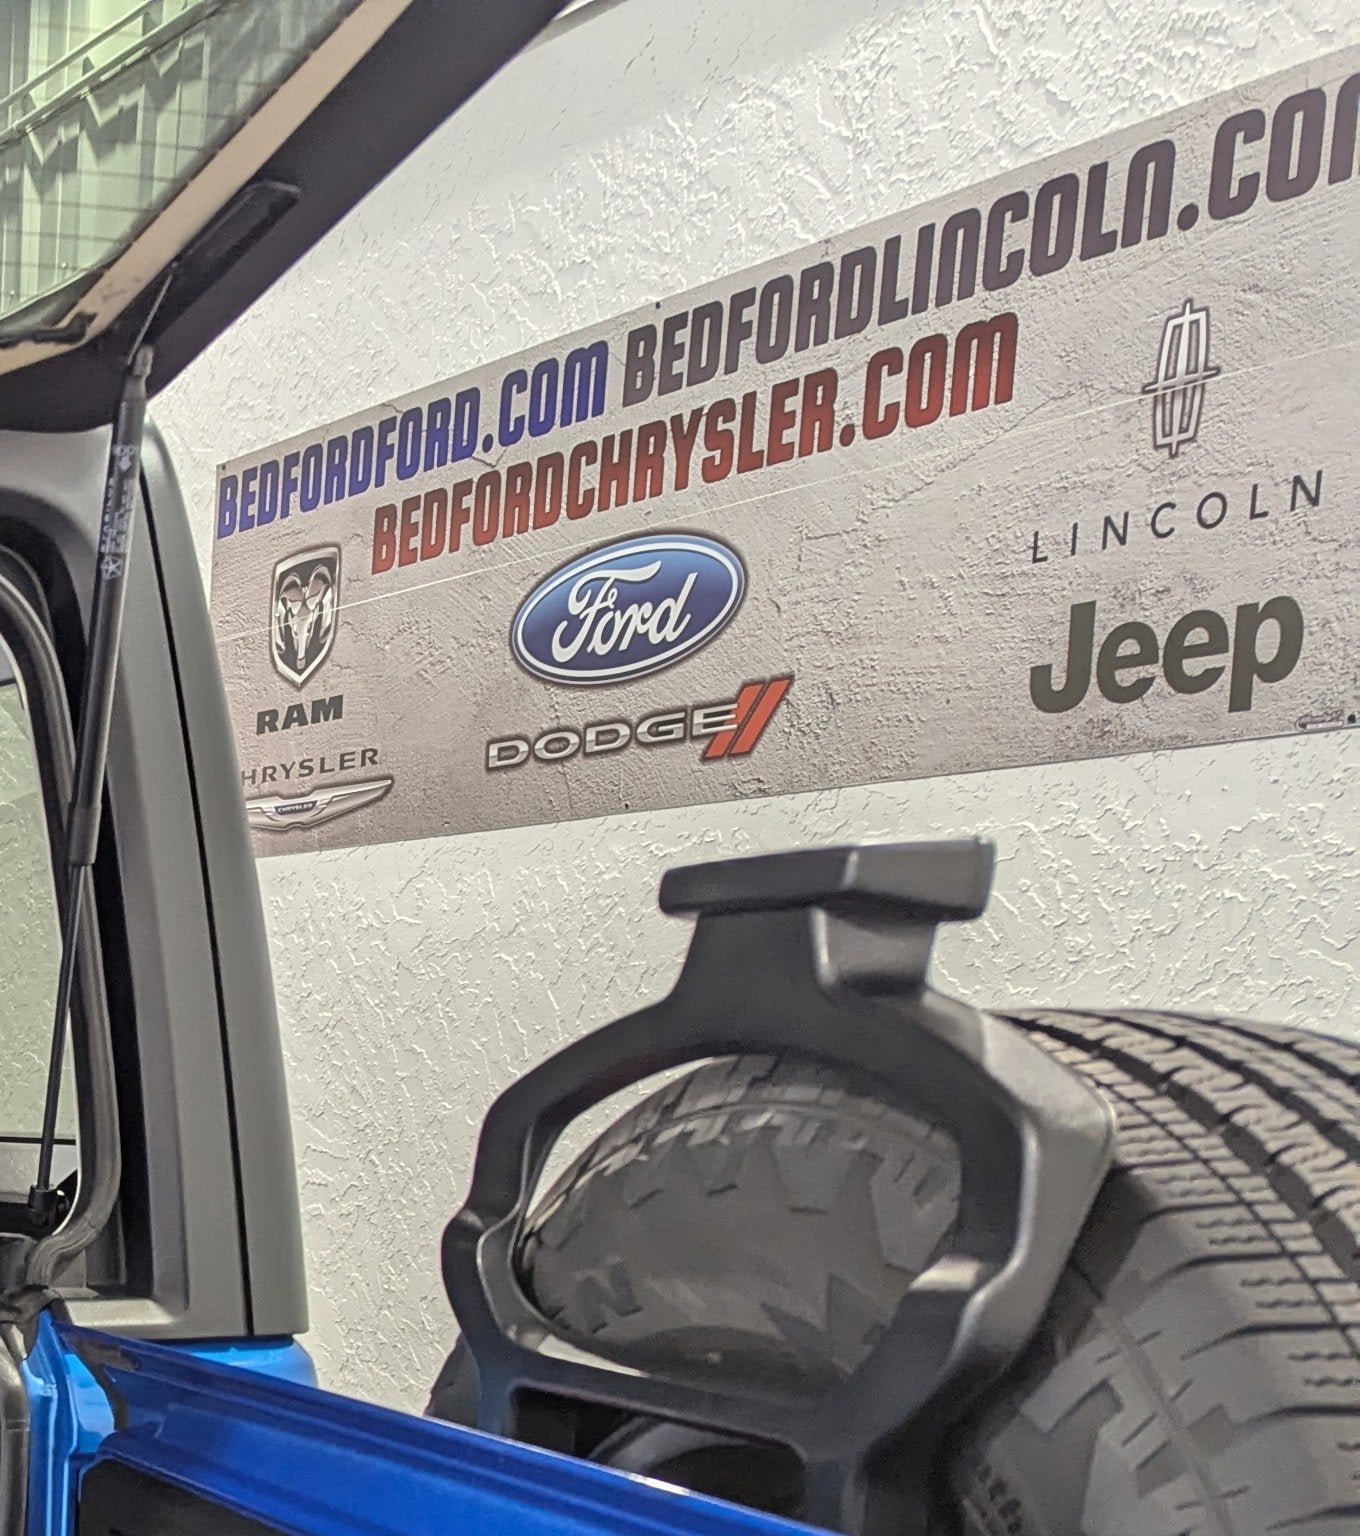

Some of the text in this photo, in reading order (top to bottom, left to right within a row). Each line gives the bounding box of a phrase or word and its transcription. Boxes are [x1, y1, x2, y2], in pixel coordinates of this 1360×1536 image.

[217, 340, 609, 539] BEDFORDFORD.COM
[371, 312, 1018, 575] BEDFORDCHRYSLER.COM
[1032, 470, 1322, 564] LINCOLN
[551, 560, 698, 663] Ford
[1030, 595, 1304, 713] Jeep
[256, 695, 343, 736] RAM
[487, 703, 739, 769] DODGE
[241, 748, 379, 785] HRYSLER
